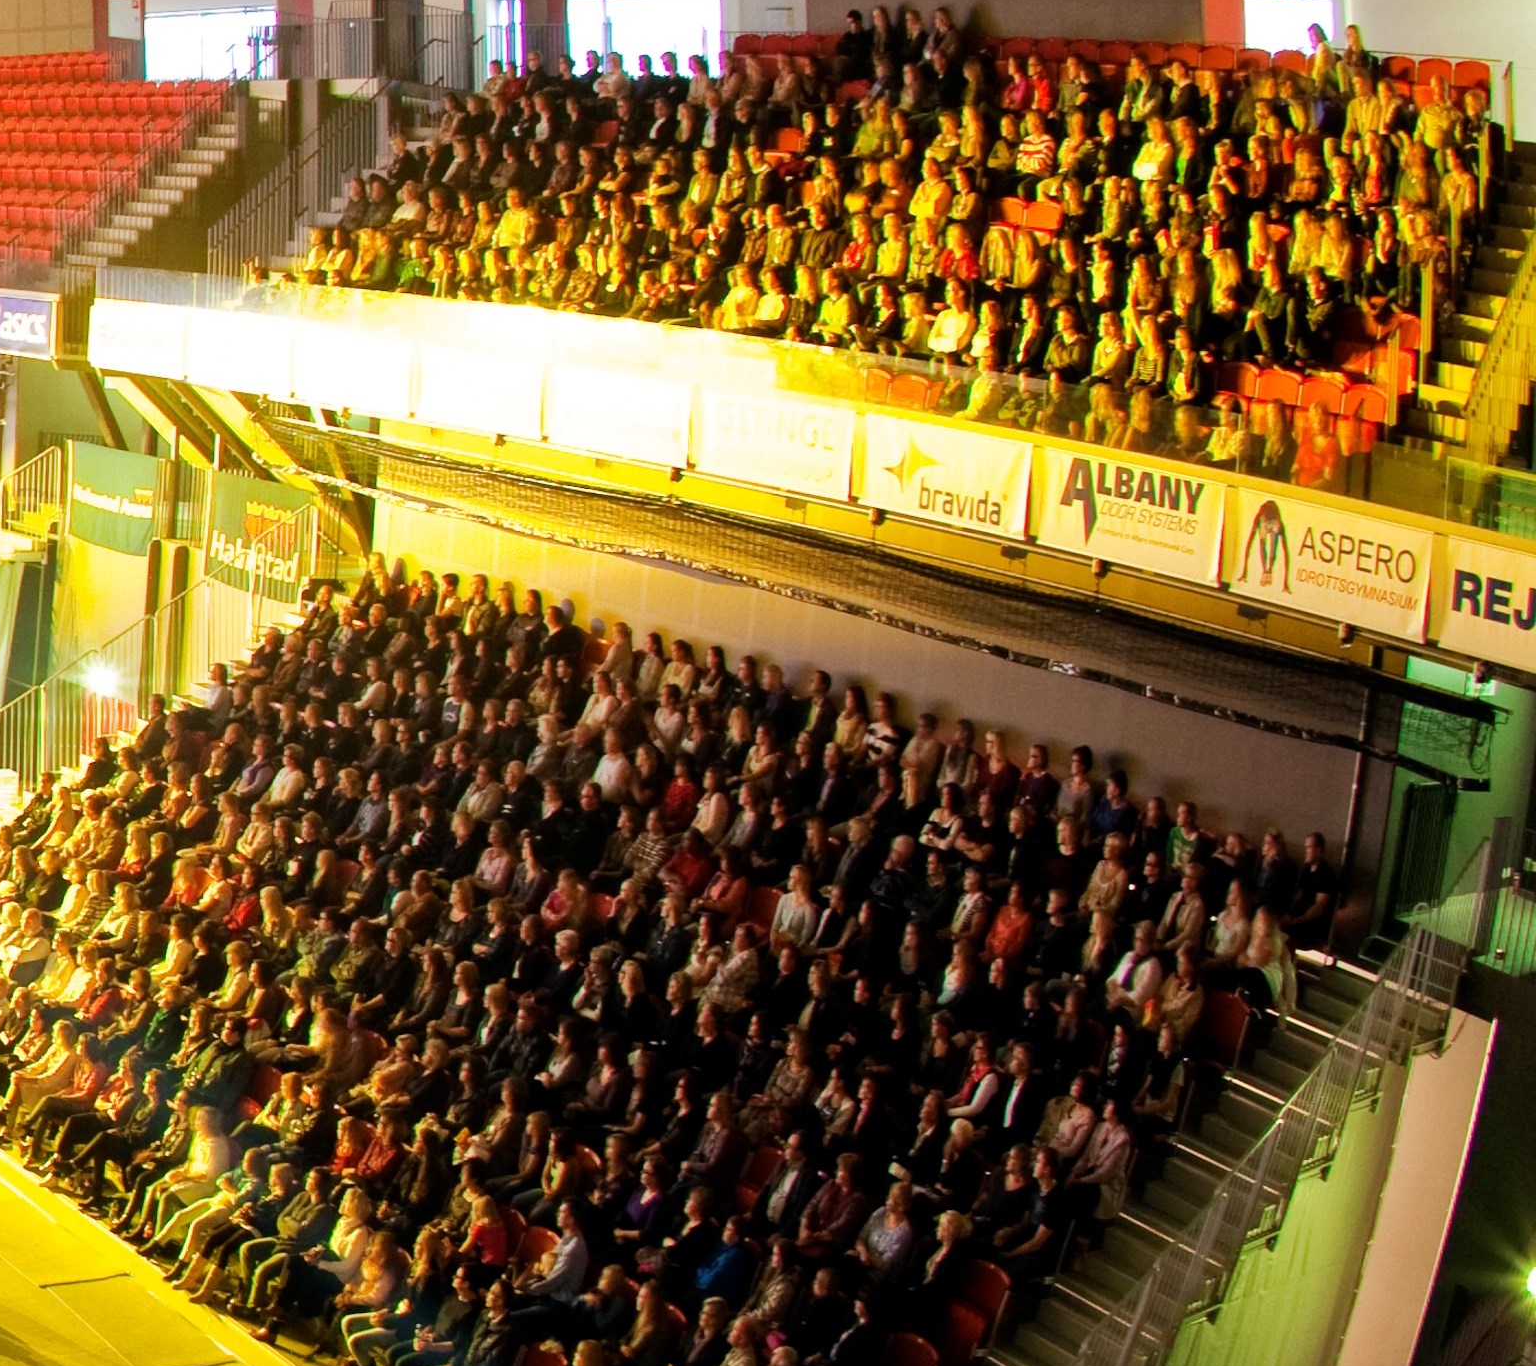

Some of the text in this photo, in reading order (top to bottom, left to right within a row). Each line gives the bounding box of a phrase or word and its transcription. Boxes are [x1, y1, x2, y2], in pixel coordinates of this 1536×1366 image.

[918, 477, 1002, 526] bravida
[1060, 458, 1204, 546] ALBANY
[1099, 500, 1198, 535] DOOR SYSTEMS
[1298, 526, 1417, 584] ASPERO
[1295, 567, 1418, 612] IDROTTSGYMNASIUM
